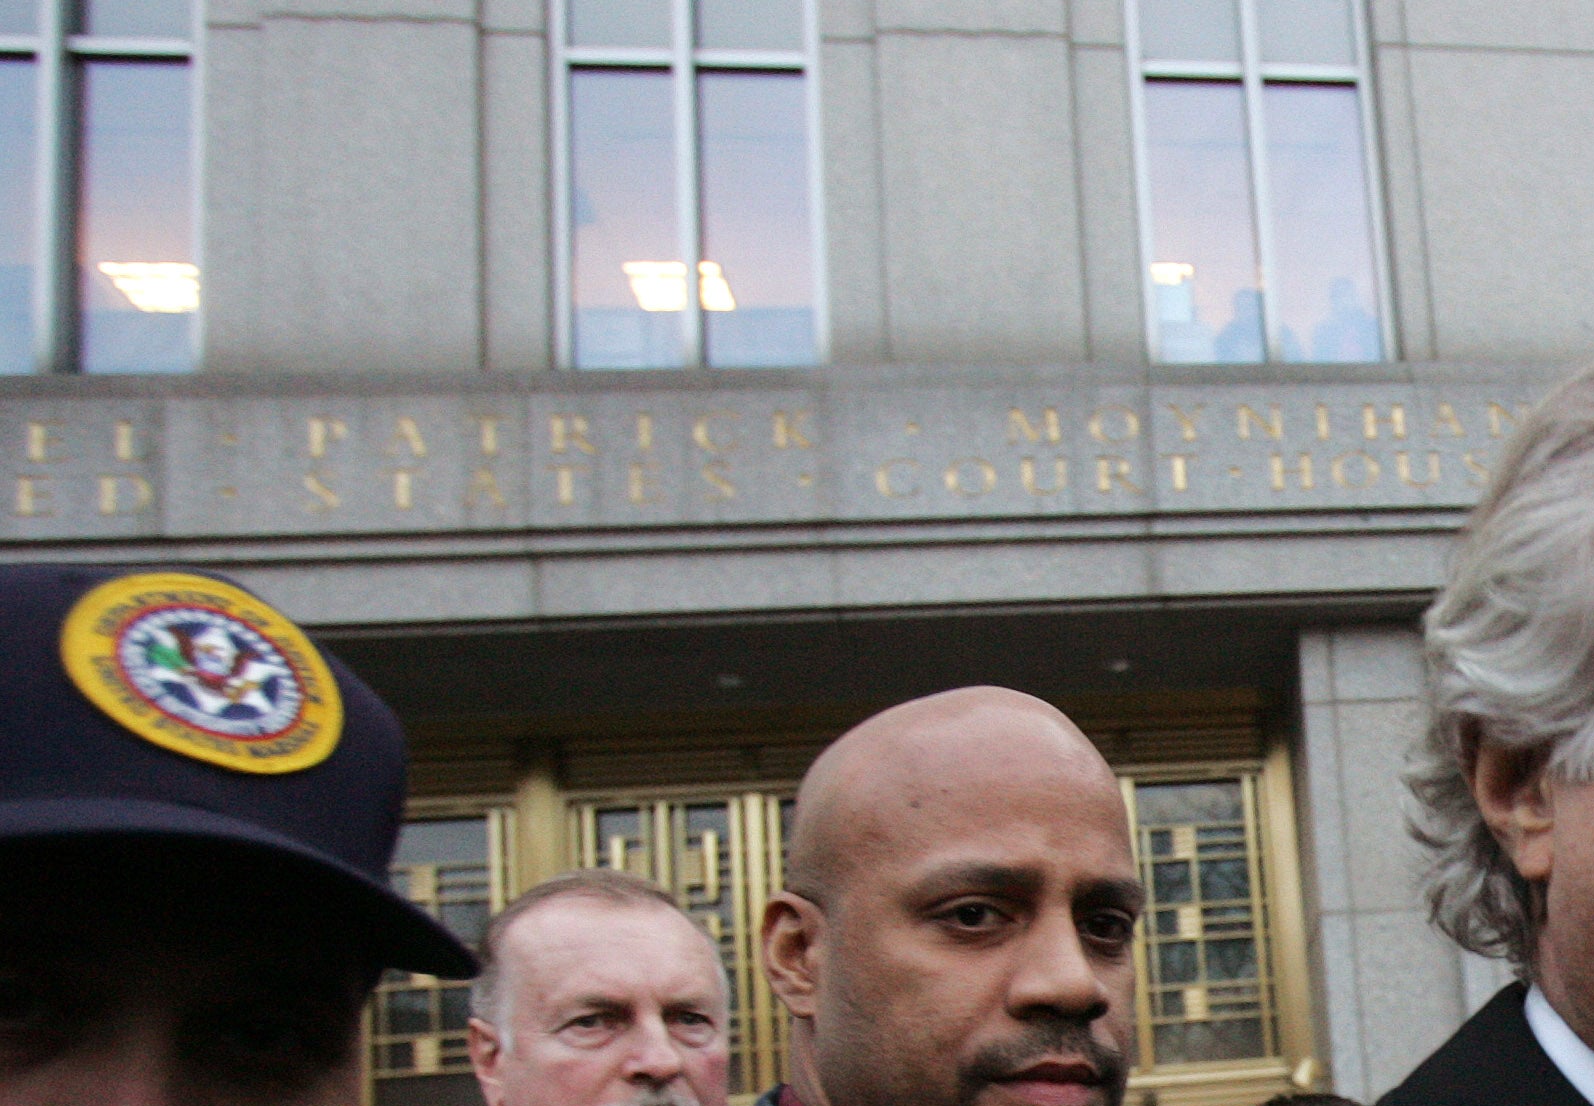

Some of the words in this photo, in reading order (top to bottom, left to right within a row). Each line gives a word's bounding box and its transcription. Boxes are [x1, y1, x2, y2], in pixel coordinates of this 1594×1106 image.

[305, 409, 816, 459] PATRICK
[303, 460, 738, 513] STATES
[873, 453, 1195, 500] COURT
